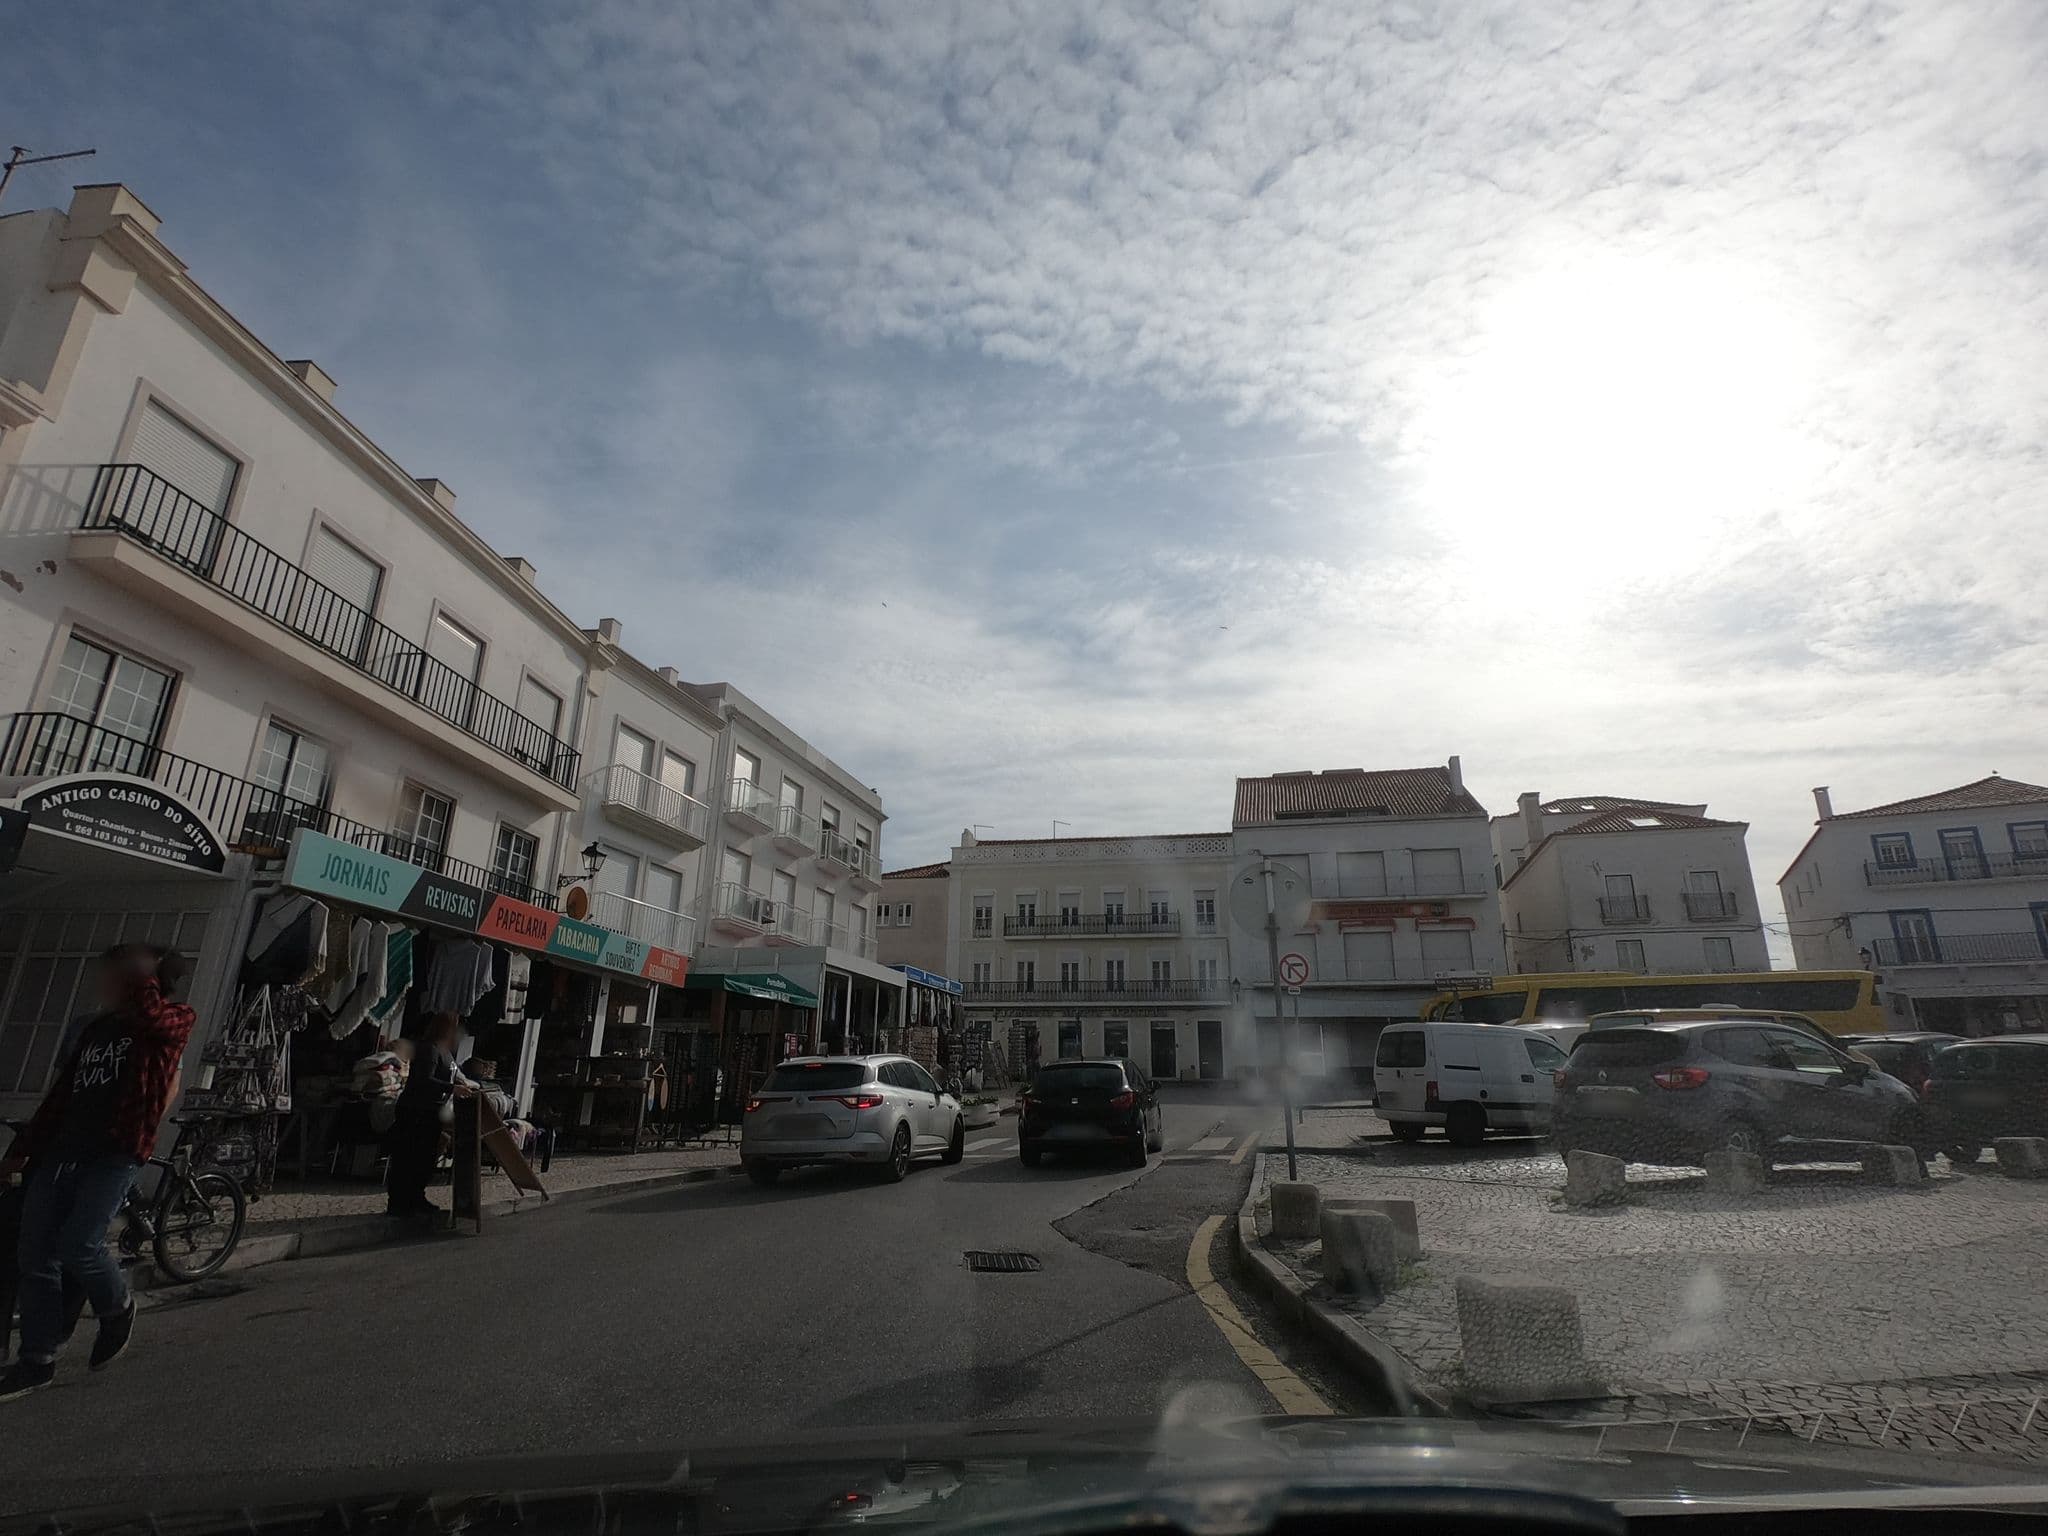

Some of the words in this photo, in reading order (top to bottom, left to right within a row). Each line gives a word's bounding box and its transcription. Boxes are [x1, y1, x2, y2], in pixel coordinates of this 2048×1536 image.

[41, 787, 102, 811] ANTIGO
[108, 788, 161, 810] CASINO
[164, 806, 183, 824] DO
[184, 824, 212, 856] SÍTIO
[320, 853, 390, 896] JORNAIS
[425, 886, 476, 919] REVISTAS
[495, 907, 548, 940] PAPELARIA
[557, 925, 600, 956] TABACARIA
